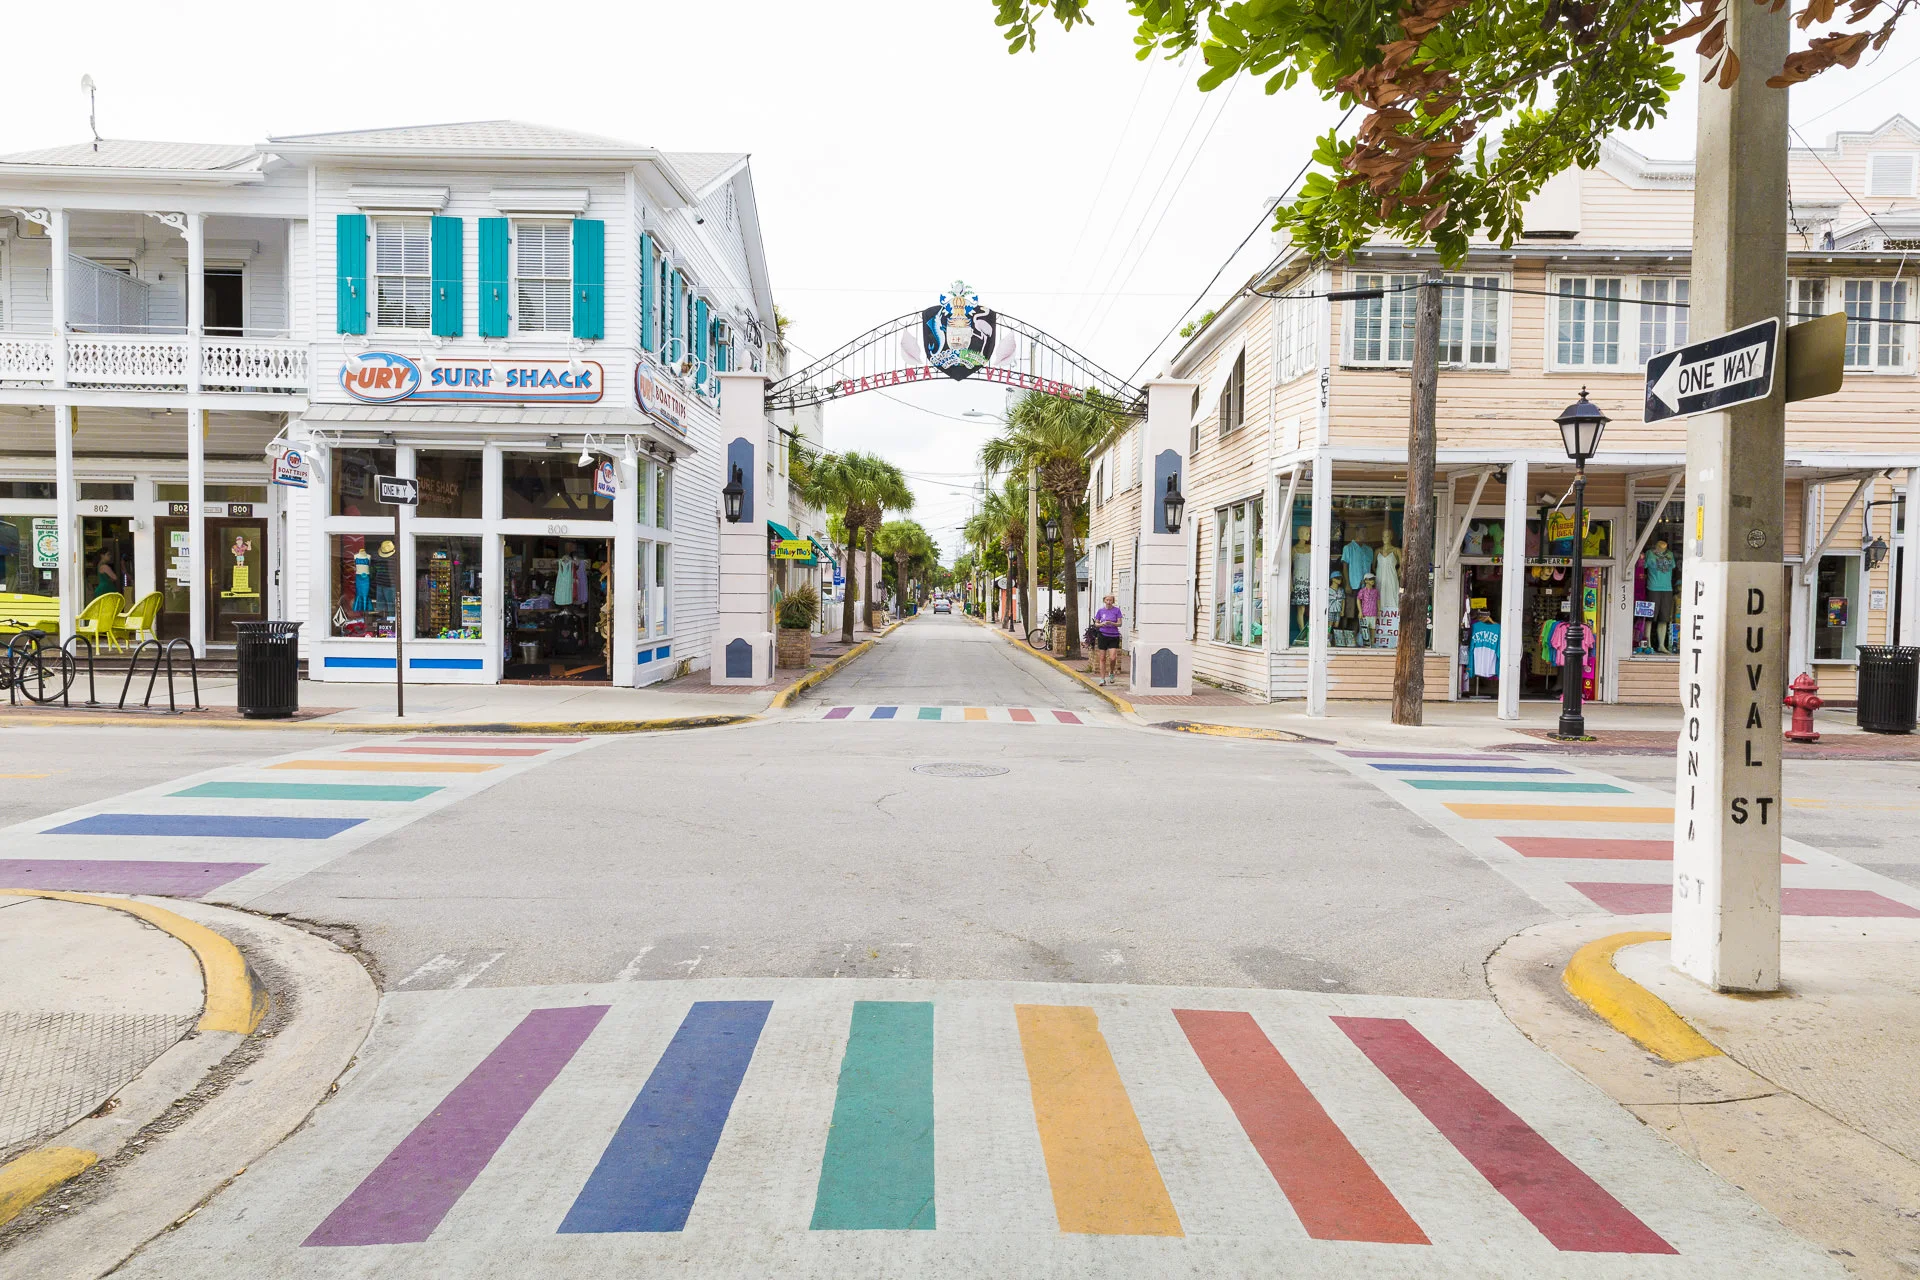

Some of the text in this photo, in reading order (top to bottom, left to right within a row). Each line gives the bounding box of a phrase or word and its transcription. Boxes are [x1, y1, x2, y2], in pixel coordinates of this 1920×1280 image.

[1678, 348, 1759, 394] ONE WAY
[345, 367, 411, 390] FURY
[431, 367, 593, 389] SURF SHACK
[842, 365, 1072, 400] BAHAMA VILLAGE
[655, 385, 671, 408] BOAT
[671, 397, 686, 419] TRIPS
[278, 467, 308, 477] BOAT TRIPS
[383, 484, 395, 496] ONE
[94, 504, 109, 513] 802
[232, 505, 247, 513] 800
[547, 524, 568, 534] 800
[1375, 618, 1392, 626] ALE
[1374, 637, 1389, 645] FF!
[1731, 588, 1774, 825] DUVAL ST
